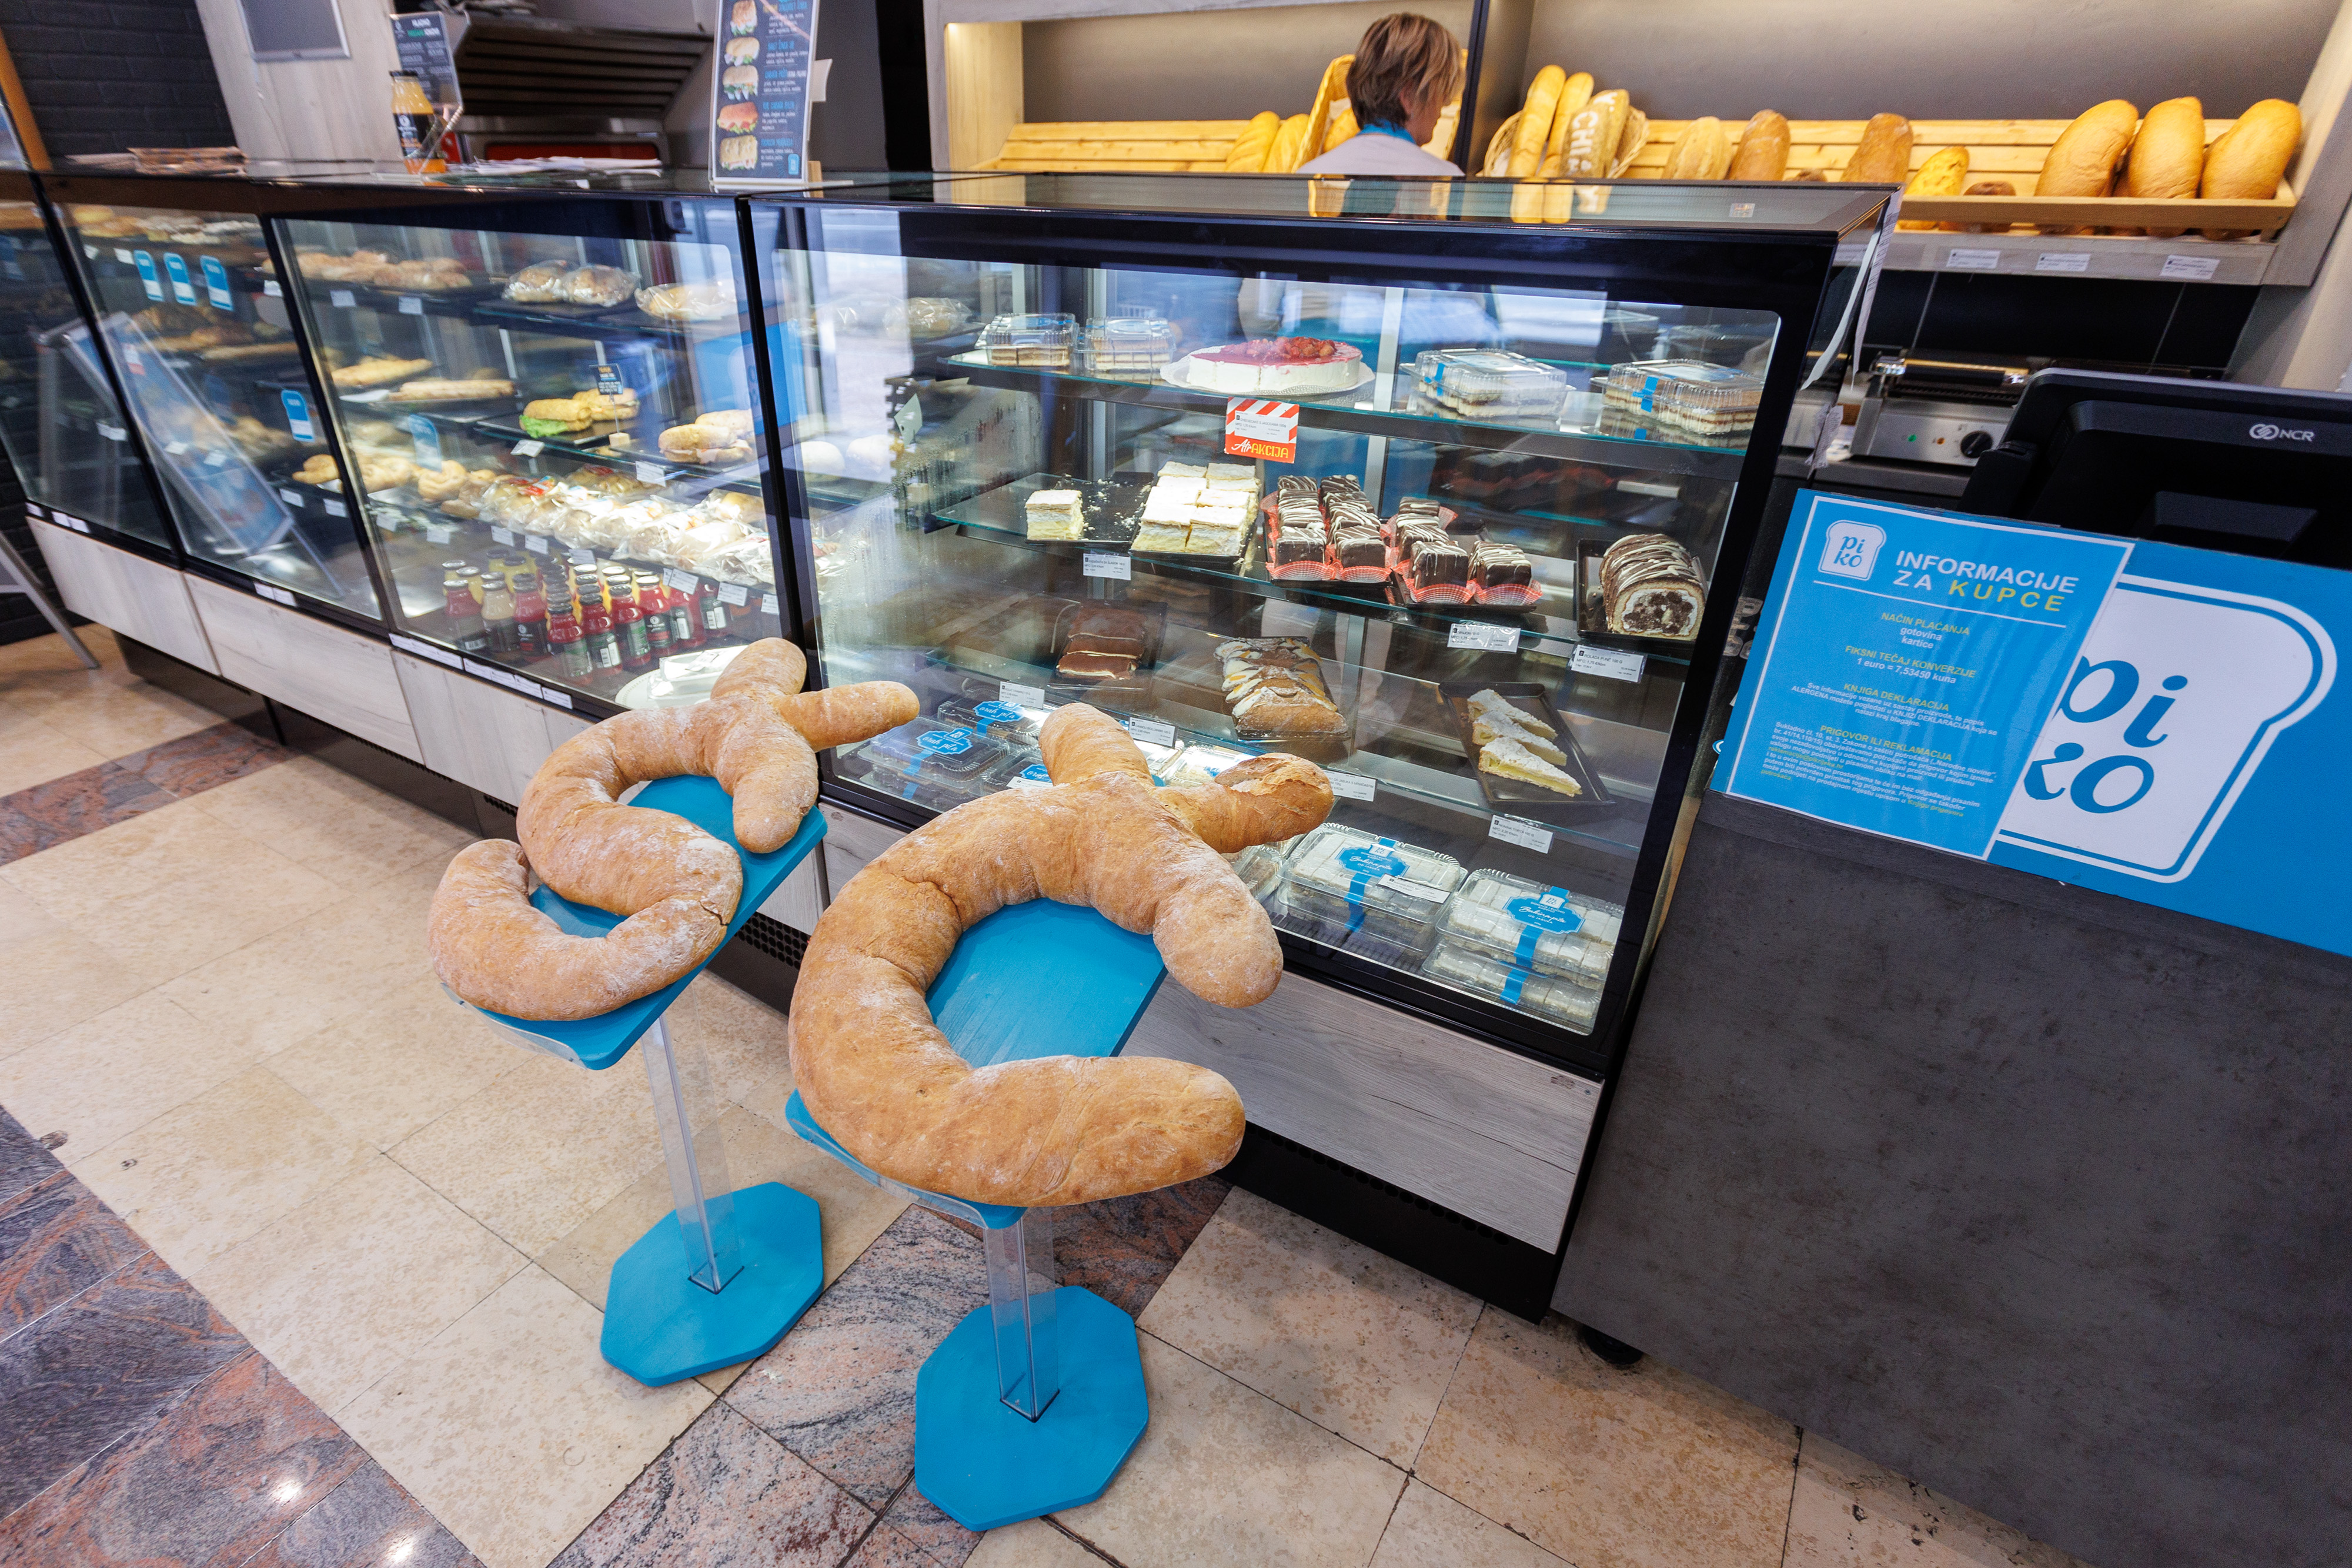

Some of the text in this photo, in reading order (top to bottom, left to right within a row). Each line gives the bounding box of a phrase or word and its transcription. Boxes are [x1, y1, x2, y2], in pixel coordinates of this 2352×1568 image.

[2279, 429, 2315, 442] NCR
[1833, 550, 1862, 567] ko
[1841, 536, 1866, 553] pi
[1895, 550, 2079, 595] INFORMACIJE
[1892, 569, 2066, 613] ZA KUPCE
[1880, 610, 1972, 636] NAČIN PLAĆANJA
[1899, 626, 1943, 643] gotovina
[1900, 636, 1935, 649] kartice
[1844, 645, 1977, 678] FIKSNI TEČAJ KONVERZIJE
[1855, 657, 1862, 665] 1
[1863, 660, 1886, 670] euro
[1894, 665, 1932, 680] 7,53450
[1932, 673, 1957, 684] kuna
[1790, 685, 1830, 699] ALERGENA
[1828, 694, 1854, 706] možete
[1853, 700, 1887, 713] pogledati
[1892, 708, 1917, 719] KNJIZI
[1917, 714, 1971, 730] DEKLARACIJA
[1970, 725, 1988, 735] koja
[1806, 682, 1820, 690] Sve
[1819, 686, 1858, 700] informacije
[1857, 695, 1882, 705] vezane
[1892, 702, 1916, 713] sastav
[1916, 707, 1955, 721] proizvoda,
[1962, 717, 1985, 727] popis
[1843, 683, 1950, 712] KNJIGA DEKLARACIJA
[1854, 707, 1922, 728] nalazi kraj blagajne.
[1769, 740, 1792, 750] uslugu
[1791, 745, 1810, 755] mogu
[1810, 750, 1839, 762] podnijeti
[1845, 759, 1874, 771] pisanom
[1874, 766, 1896, 775] obliku
[1775, 721, 1806, 733] Sukladno
[1842, 738, 1867, 748] Zakona
[1872, 745, 1894, 755] zaštiti
[1893, 750, 1930, 765] potrošača
[1819, 725, 1953, 761] PRIGOVOR ILI REKLAMACIJA
[1771, 734, 1789, 743] svoje
[1789, 738, 1837, 755] nezadovoljstvo
[1843, 752, 1869, 762] odnosu
[1878, 760, 1906, 772] kupljeni
[1906, 766, 1937, 778] proizvod
[1945, 775, 1976, 788] pruženu
[1823, 740, 1873, 757] obavještavamo
[1873, 753, 1907, 765] potrošače
[1917, 763, 1949, 774] prigovor
[1947, 770, 1969, 780] kojim
[1969, 774, 1993, 784] iznose
[1763, 757, 1784, 767] putem
[1823, 773, 1851, 784] primitak
[1863, 783, 1898, 796] prigovora.
[1897, 790, 1929, 803] Prigovor
[1779, 768, 1808, 779] podnijeti
[1816, 777, 1852, 791] prodajnom
[1851, 786, 1875, 797] mjestu
[1874, 792, 1900, 803] upisom
[1798, 760, 1832, 773] poslovnim
[1832, 768, 1874, 784] prostorijama
[1950, 795, 1981, 808] pisanim
[1349, 855, 1378, 867] Bakina
[1519, 906, 1566, 923] Bakina pita
